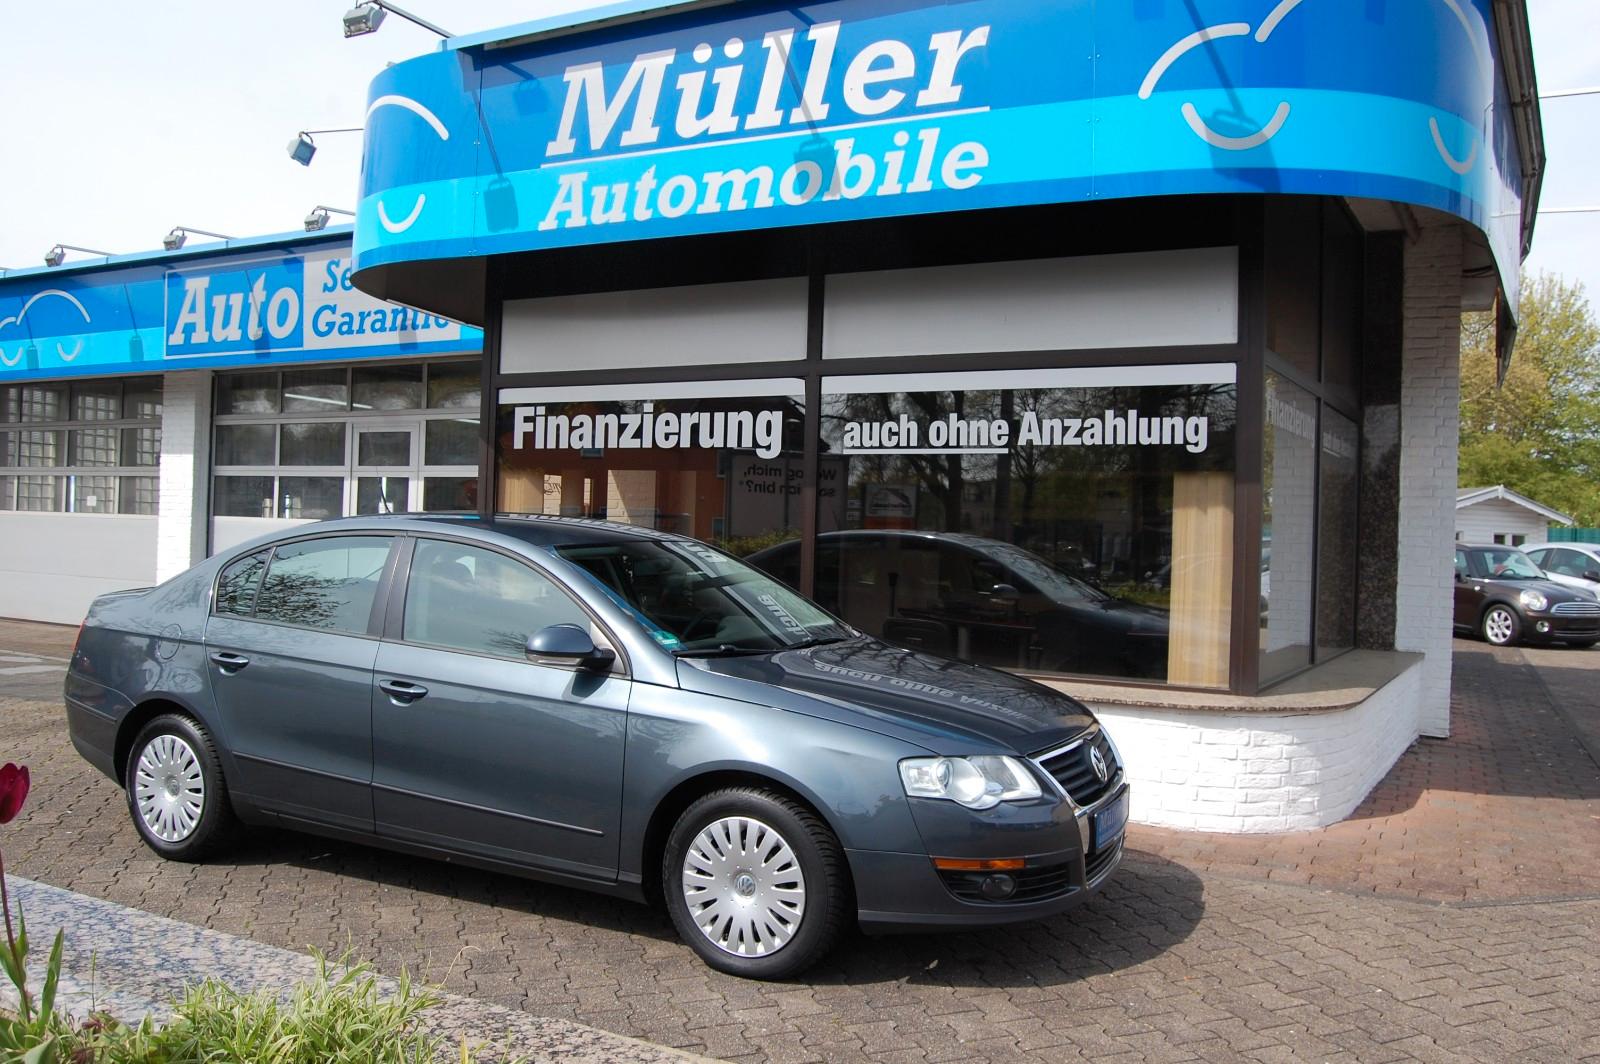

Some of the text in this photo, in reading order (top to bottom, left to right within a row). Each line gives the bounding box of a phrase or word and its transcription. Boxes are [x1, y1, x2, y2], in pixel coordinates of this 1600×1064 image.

[545, 19, 990, 157] Müller
[538, 127, 990, 231] Automobile
[168, 272, 299, 346] Auto
[513, 403, 783, 459] Finanzierung
[843, 409, 1208, 453] auch ohne Anzahlung
